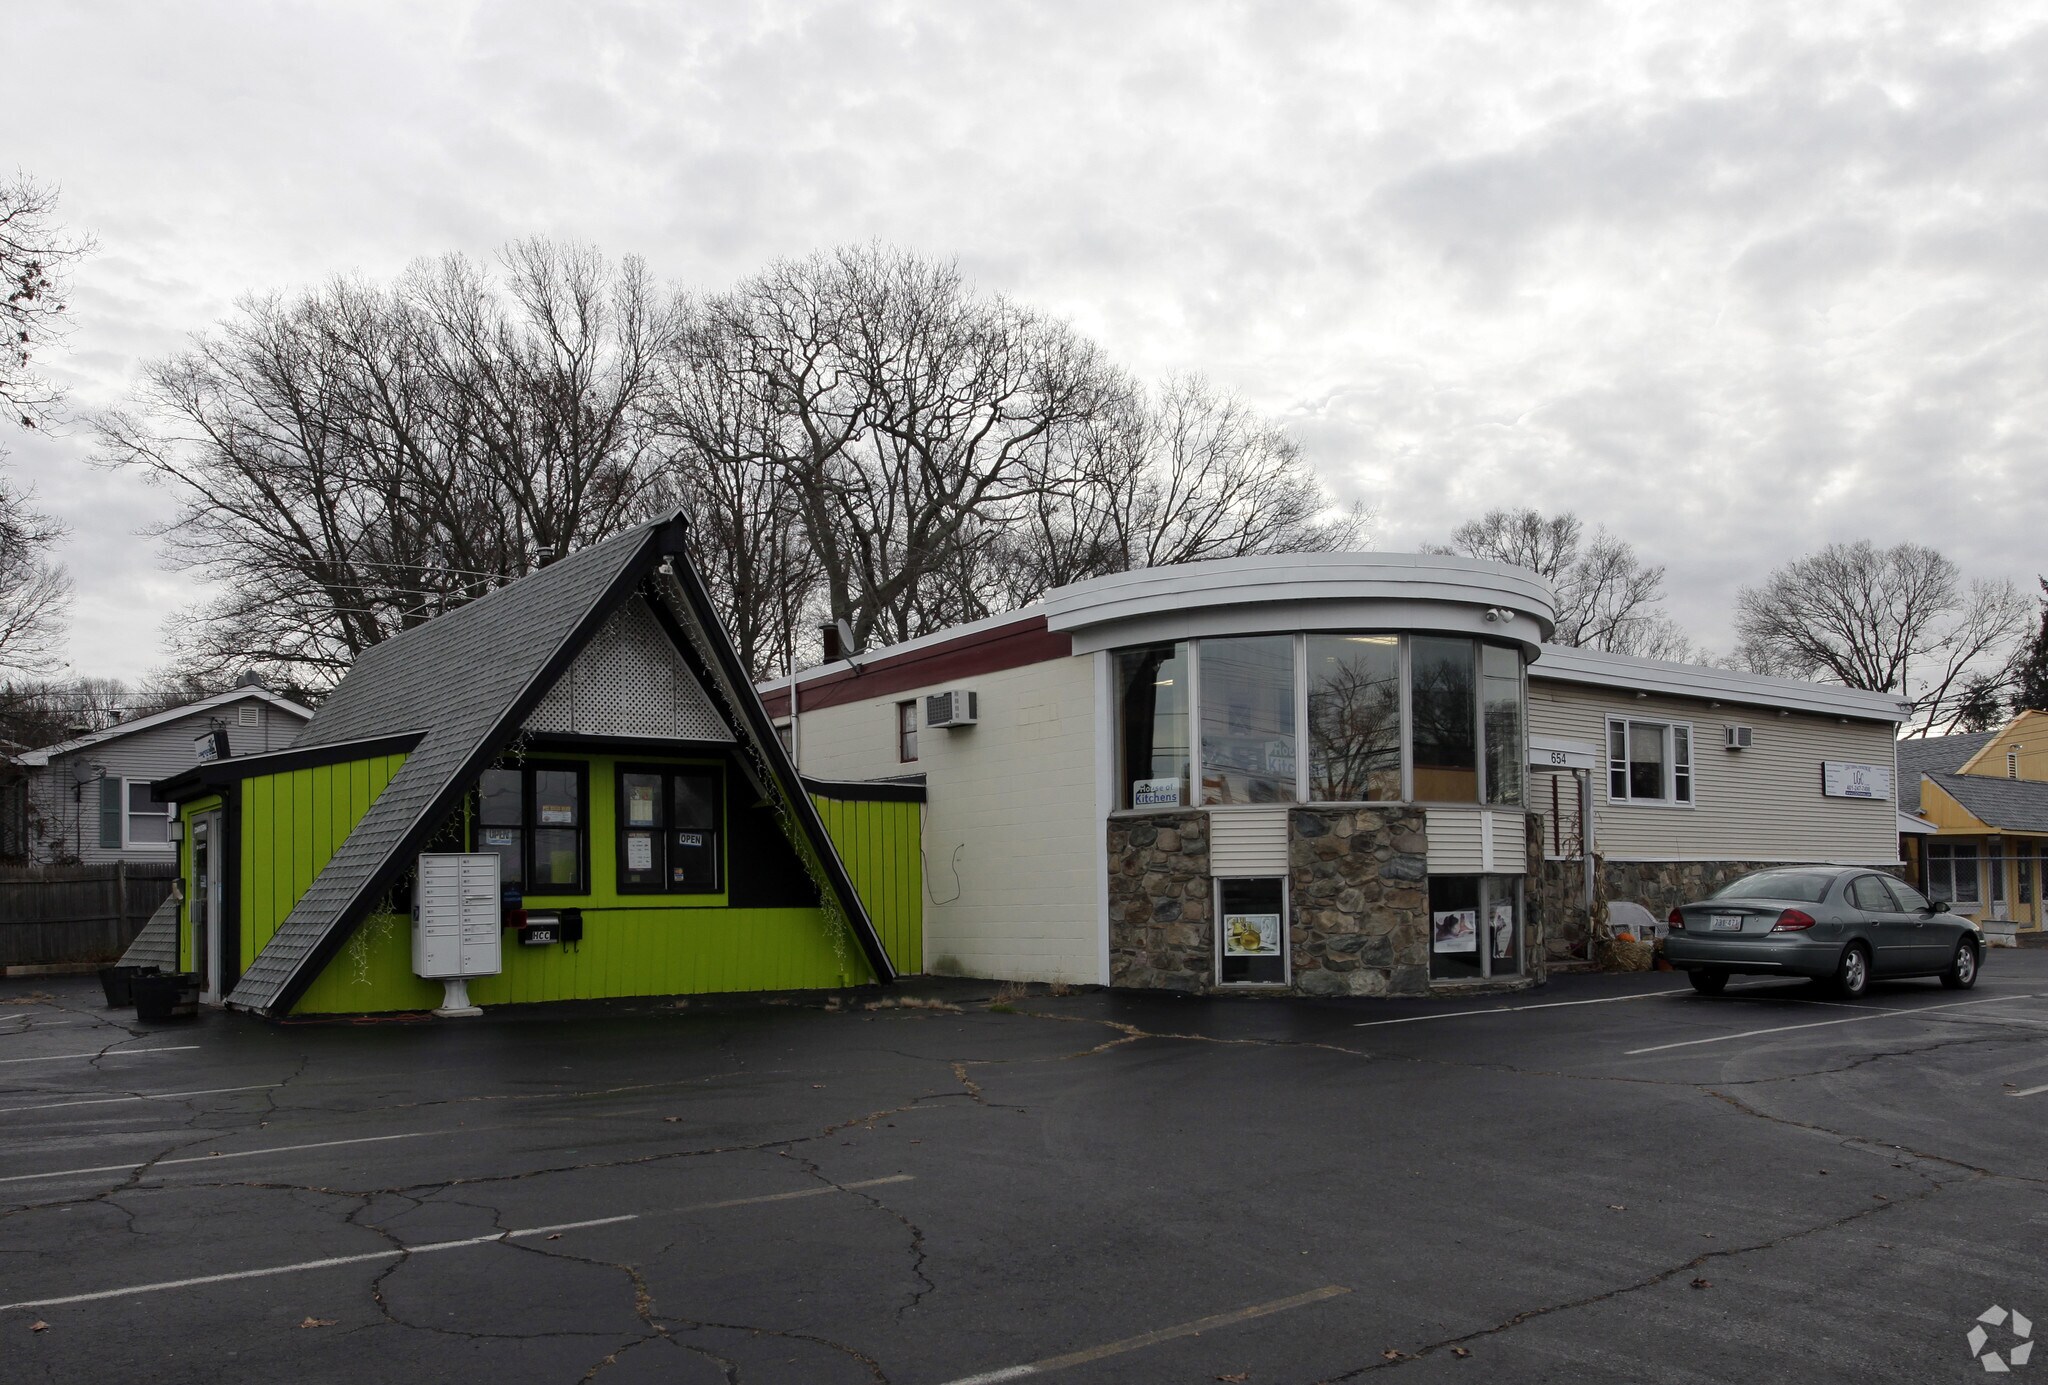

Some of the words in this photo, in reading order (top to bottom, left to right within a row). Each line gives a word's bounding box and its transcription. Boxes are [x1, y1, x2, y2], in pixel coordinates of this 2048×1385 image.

[1551, 752, 1566, 764] 654
[1853, 770, 1864, 785] LGC
[1139, 784, 1164, 793] House
[1136, 793, 1177, 803] Kitchens
[680, 834, 701, 844] OPEN
[533, 931, 550, 940] HCC
